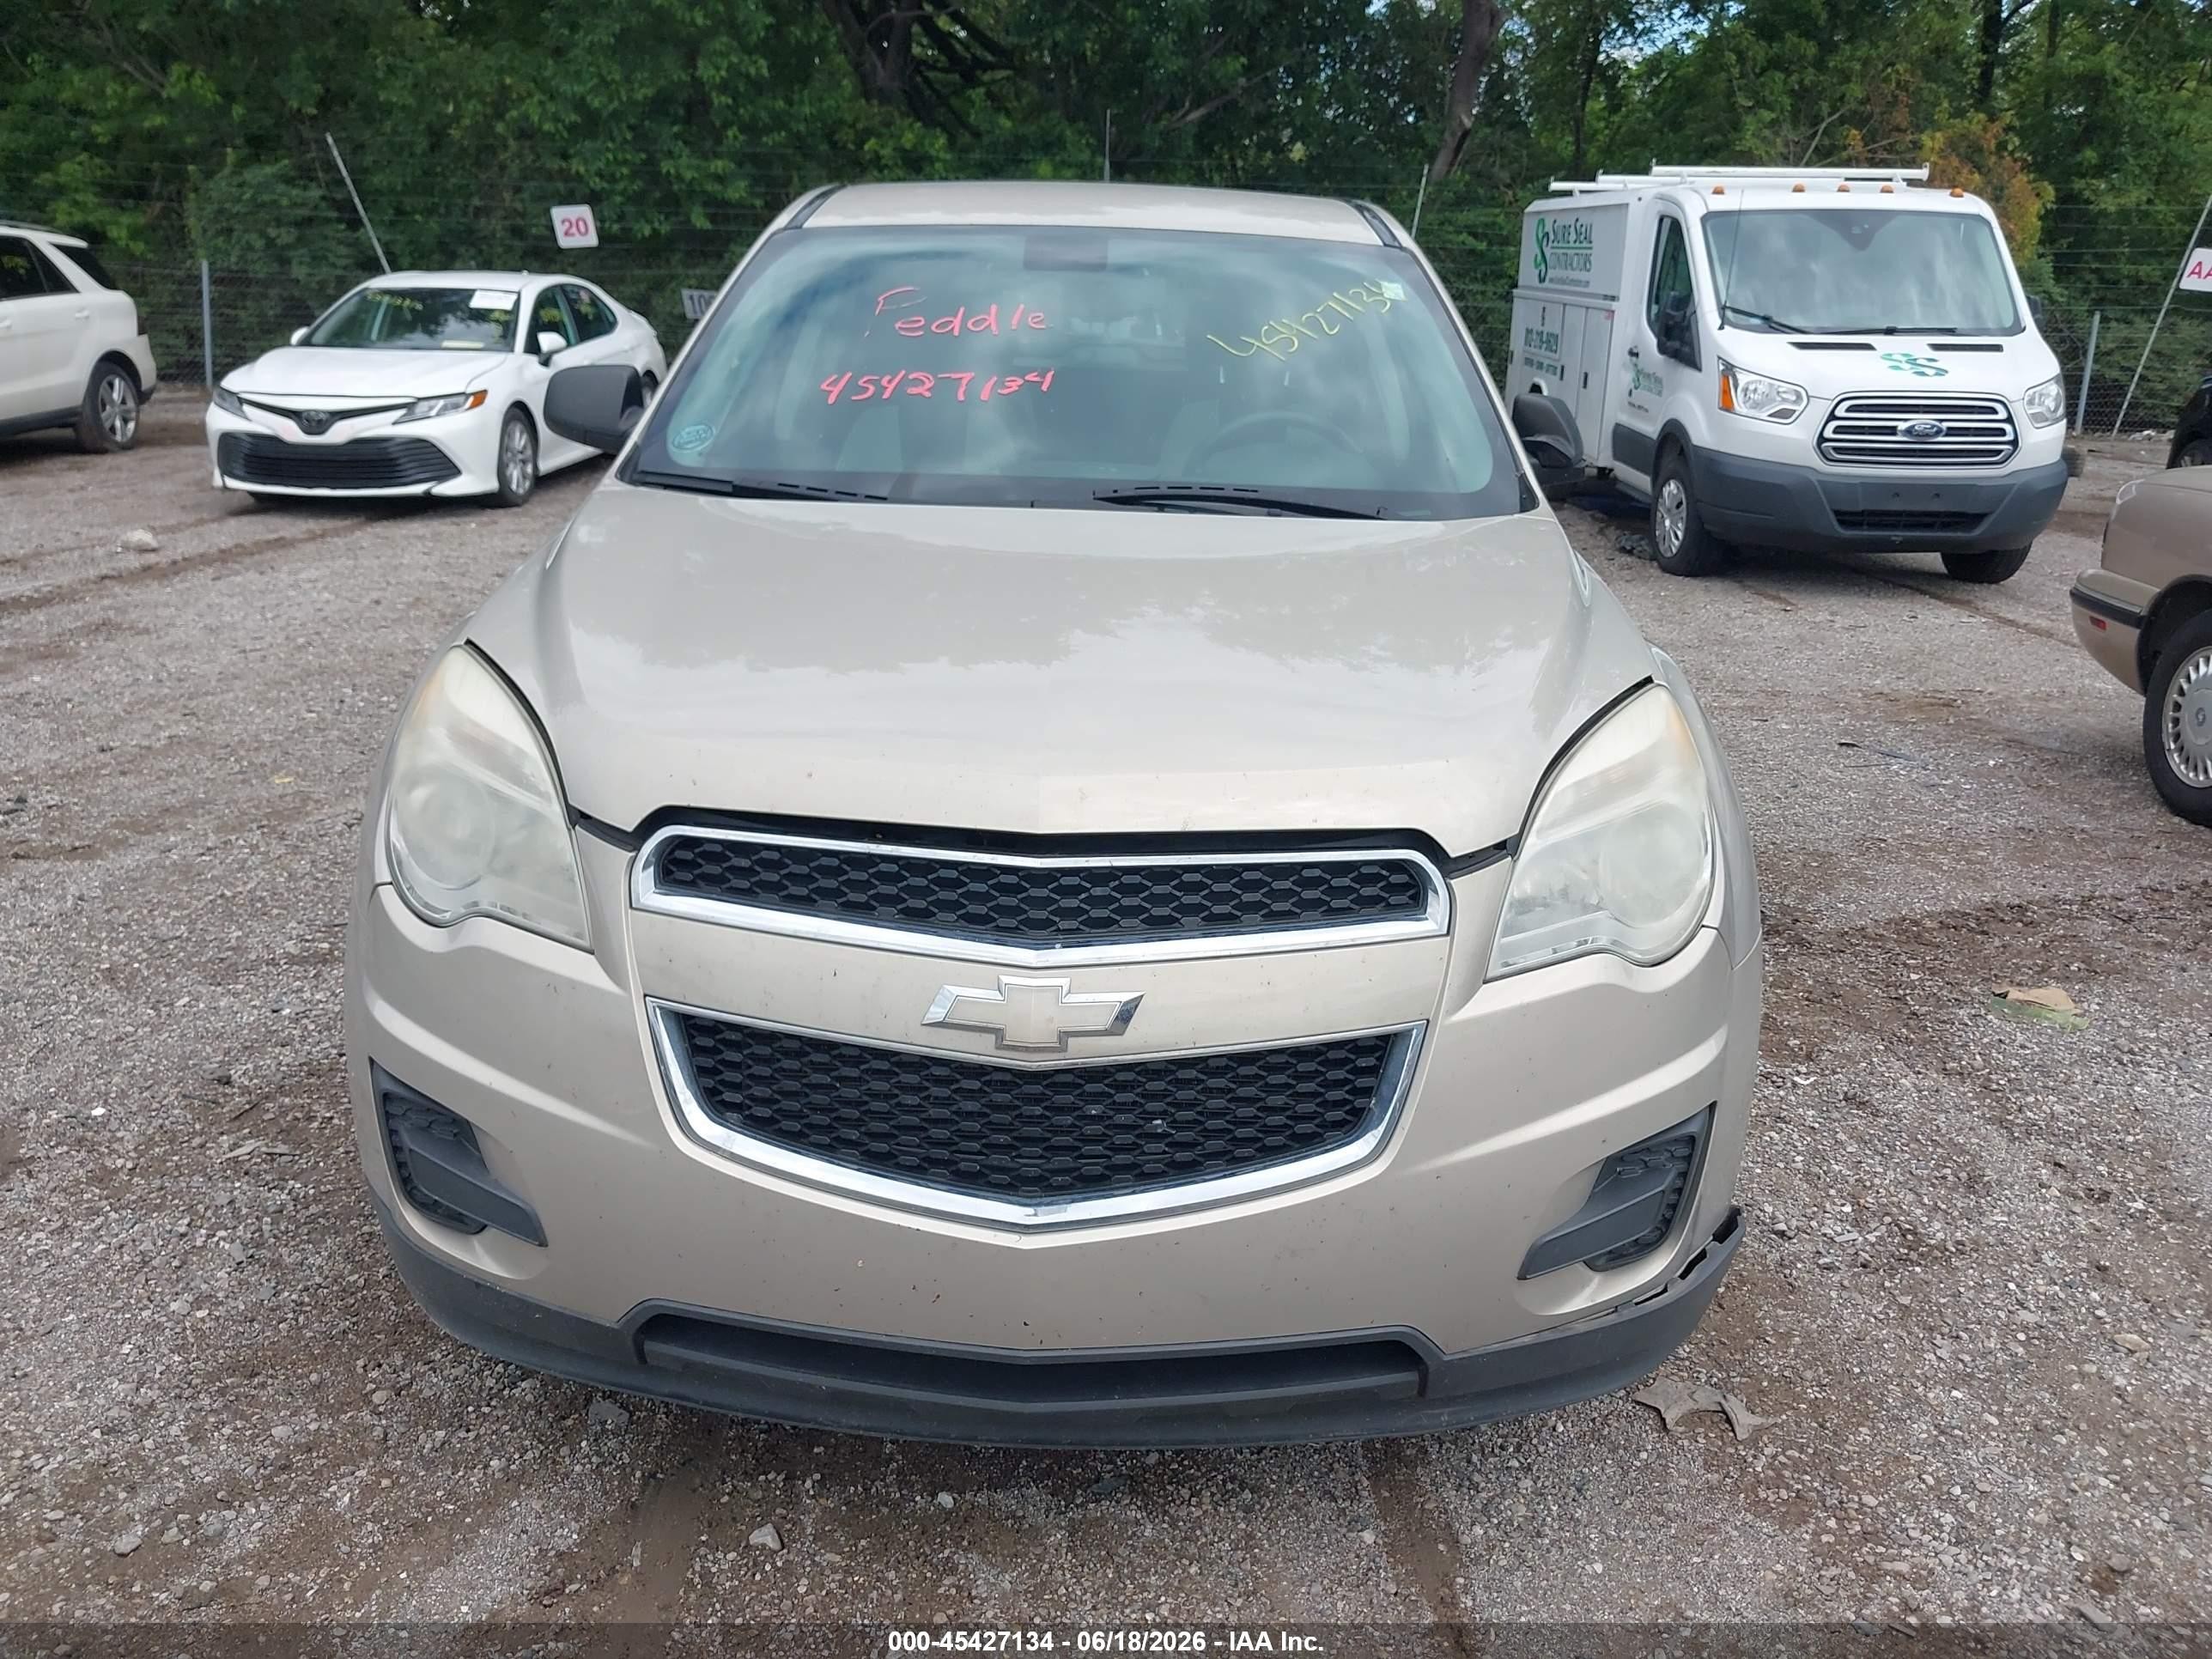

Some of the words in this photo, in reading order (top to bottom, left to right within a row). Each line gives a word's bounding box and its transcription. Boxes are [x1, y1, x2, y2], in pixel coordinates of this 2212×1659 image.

[561, 216, 589, 237] 20
[1552, 218, 1571, 245] SURE
[1573, 217, 1593, 245] SEAL
[864, 286, 1048, 337] Feddle
[820, 369, 1054, 405] 45427134
[1912, 424, 1938, 435] Ford
